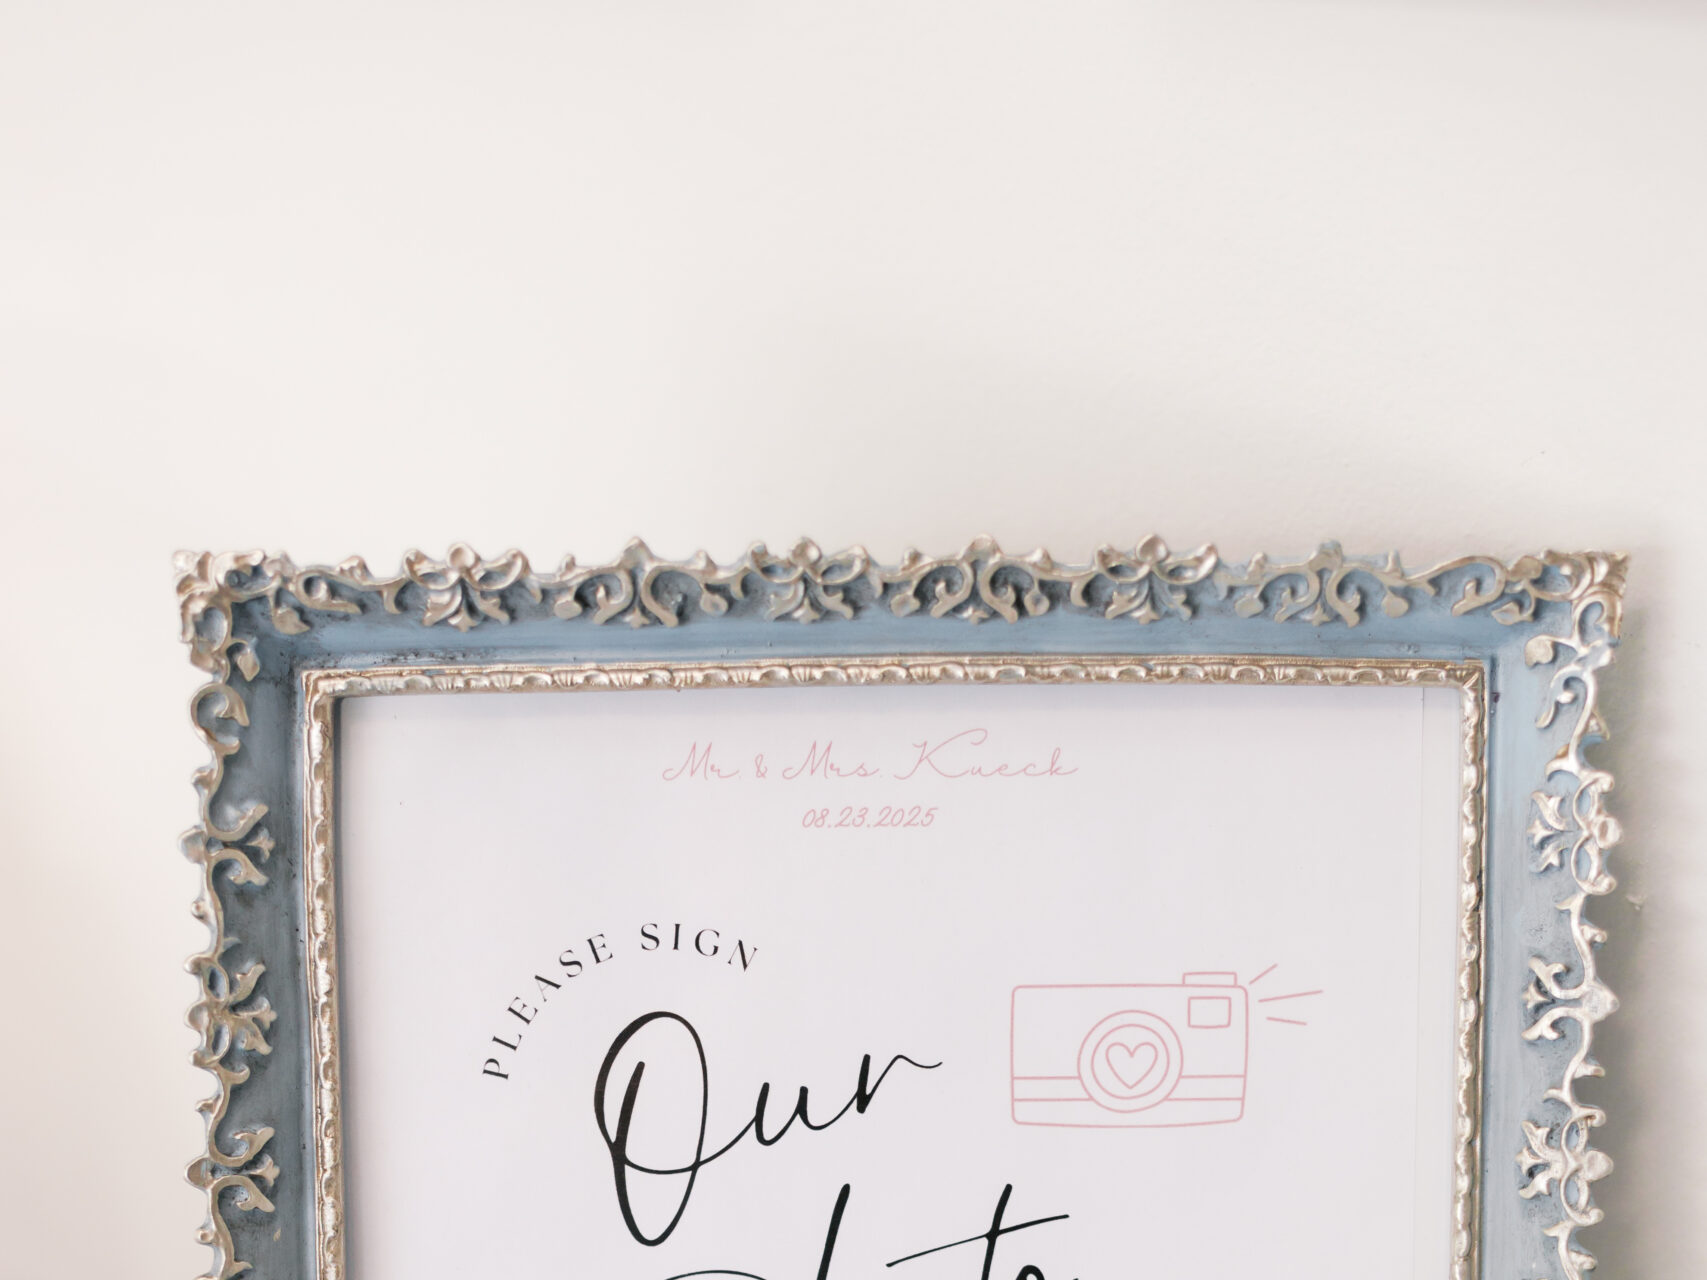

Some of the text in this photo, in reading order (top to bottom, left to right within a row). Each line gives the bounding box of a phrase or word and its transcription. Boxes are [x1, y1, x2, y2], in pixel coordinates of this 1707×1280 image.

[754, 752, 769, 780] &
[893, 726, 1079, 780] Kueck
[801, 806, 939, 829] 08.23.2025
[482, 922, 758, 1080] PLEASE SIGN
[593, 1010, 944, 1248] Our
